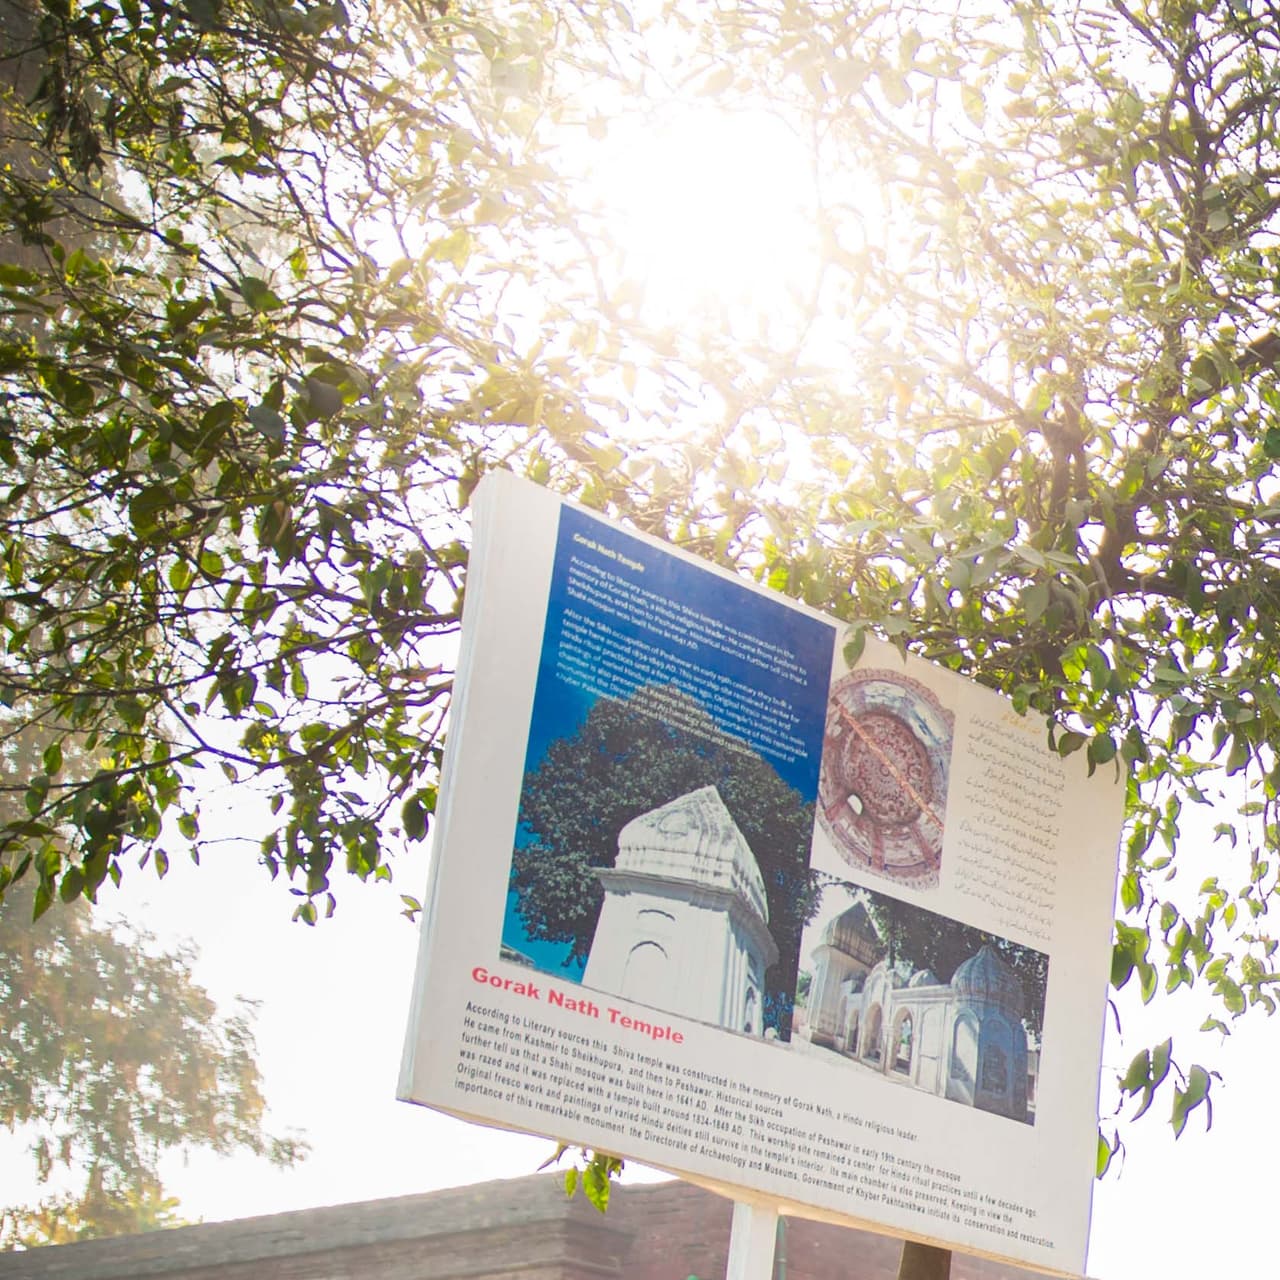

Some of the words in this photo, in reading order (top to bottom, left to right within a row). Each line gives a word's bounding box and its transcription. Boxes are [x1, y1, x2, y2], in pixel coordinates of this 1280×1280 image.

[471, 966, 540, 1000] Gorak
[547, 988, 599, 1018] Nath
[606, 1007, 684, 1044] Temple
[462, 1015, 476, 1029] He
[476, 1021, 500, 1036] came
[501, 1026, 522, 1041] from
[523, 1032, 559, 1051] Kashmir
[559, 1043, 569, 1056] to
[627, 1066, 644, 1078] and
[644, 1069, 663, 1084] then
[664, 1075, 674, 1087] to
[715, 1089, 753, 1109] Historical
[753, 1102, 783, 1118] sources
[464, 1000, 510, 1025] According
[510, 1014, 521, 1026] to
[521, 1016, 556, 1038] Literary
[557, 1029, 590, 1047] sources
[591, 1038, 608, 1052] this
[611, 1043, 635, 1060] Shiva
[636, 1051, 663, 1069] temple
[664, 1062, 680, 1074] was
[681, 1067, 728, 1087] constructed
[728, 1078, 737, 1090] in
[737, 1081, 751, 1094] the
[751, 1087, 782, 1105] memory
[782, 1094, 792, 1105] of
[791, 1096, 814, 1112] Gorak
[835, 1111, 841, 1121] a
[841, 1111, 863, 1127] Hindu
[863, 1119, 895, 1136] religious
